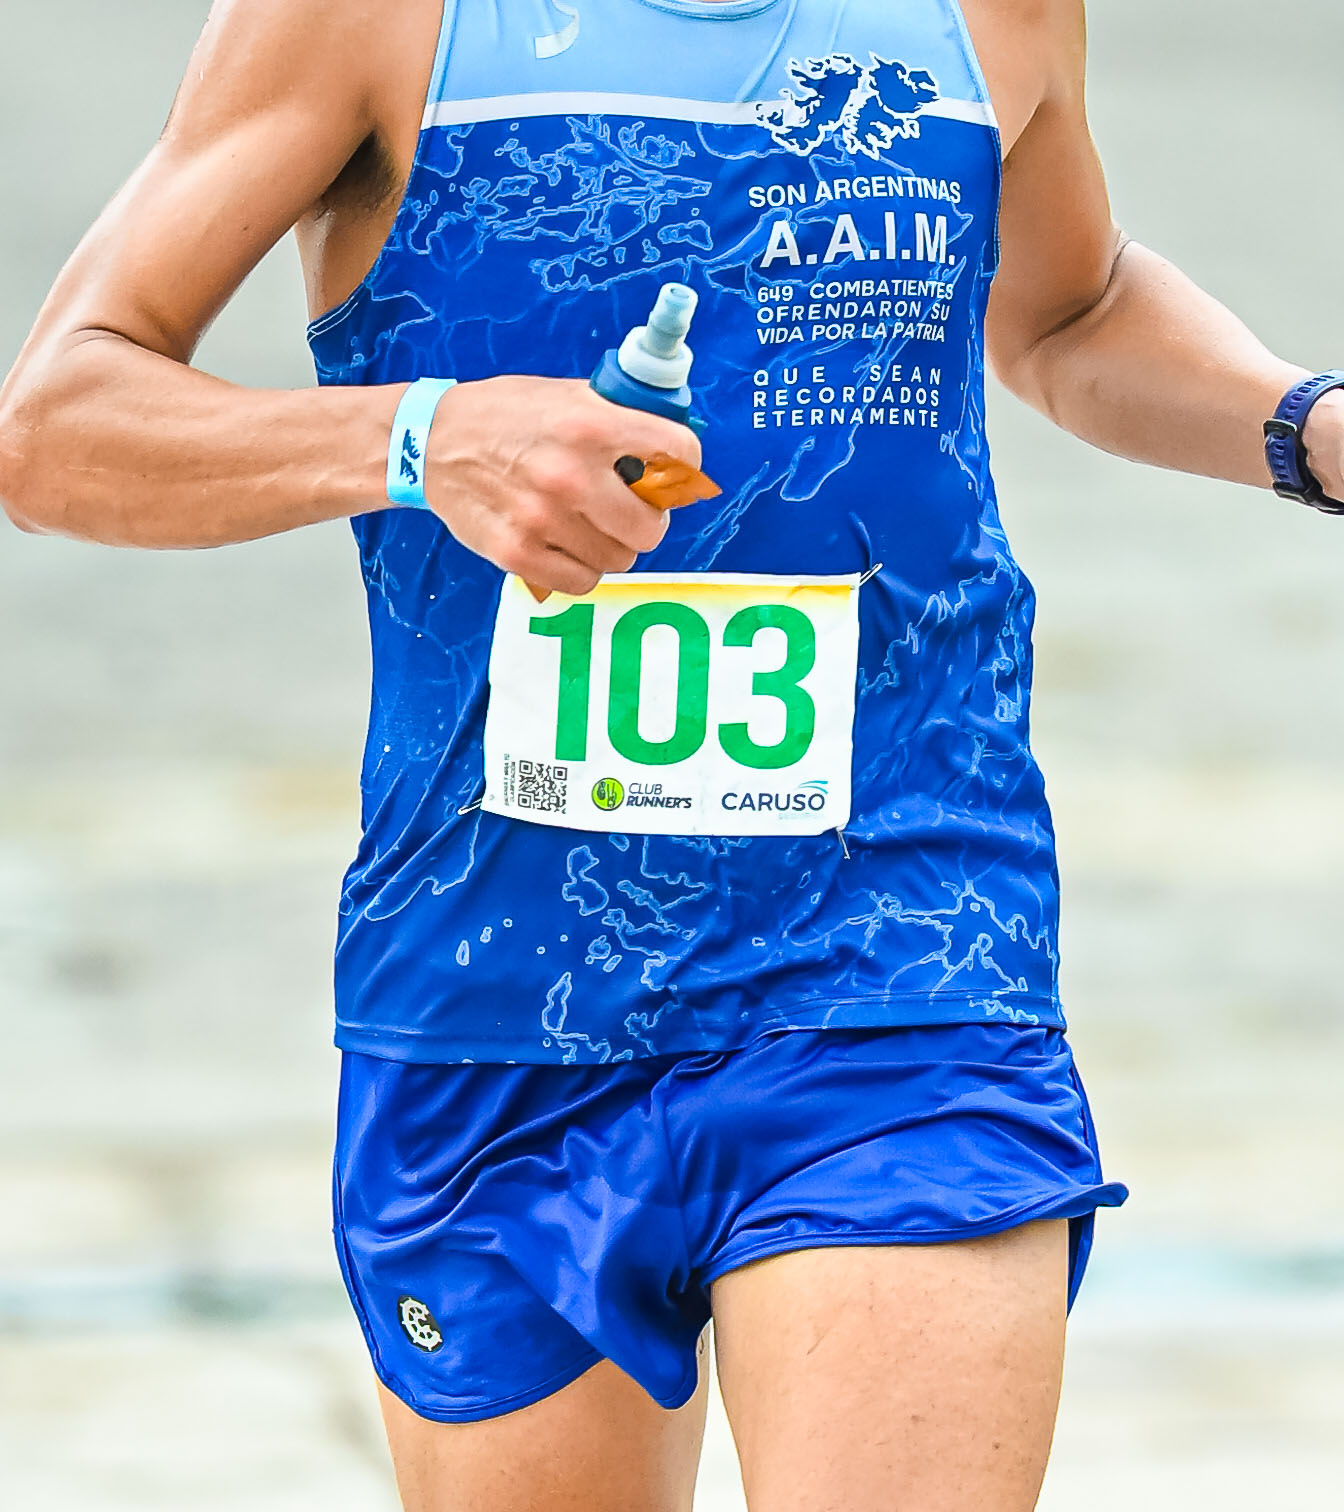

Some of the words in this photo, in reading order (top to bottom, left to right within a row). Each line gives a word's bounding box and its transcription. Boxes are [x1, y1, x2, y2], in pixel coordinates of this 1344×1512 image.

[748, 183, 806, 208] SON
[814, 175, 962, 204] ARGENTINAS
[759, 211, 956, 268] A.A.I.M.
[757, 285, 794, 303] 649
[809, 279, 954, 300] COMBATIENTES
[756, 300, 922, 324] OFRENDARON
[930, 302, 951, 321] SU
[756, 326, 805, 345] VIDA
[811, 323, 856, 341] POR
[861, 322, 888, 339] LA
[891, 322, 946, 343] PATRIA
[753, 365, 826, 386] QUE
[869, 364, 942, 385] SEAN
[752, 386, 940, 408] RECORDADOS
[752, 407, 940, 429] ETERNAMENTE
[528, 601, 817, 770] 103
[628, 782, 663, 795] CLUB
[626, 796, 692, 810] RUNNER'S
[721, 792, 826, 813] CARUSO
